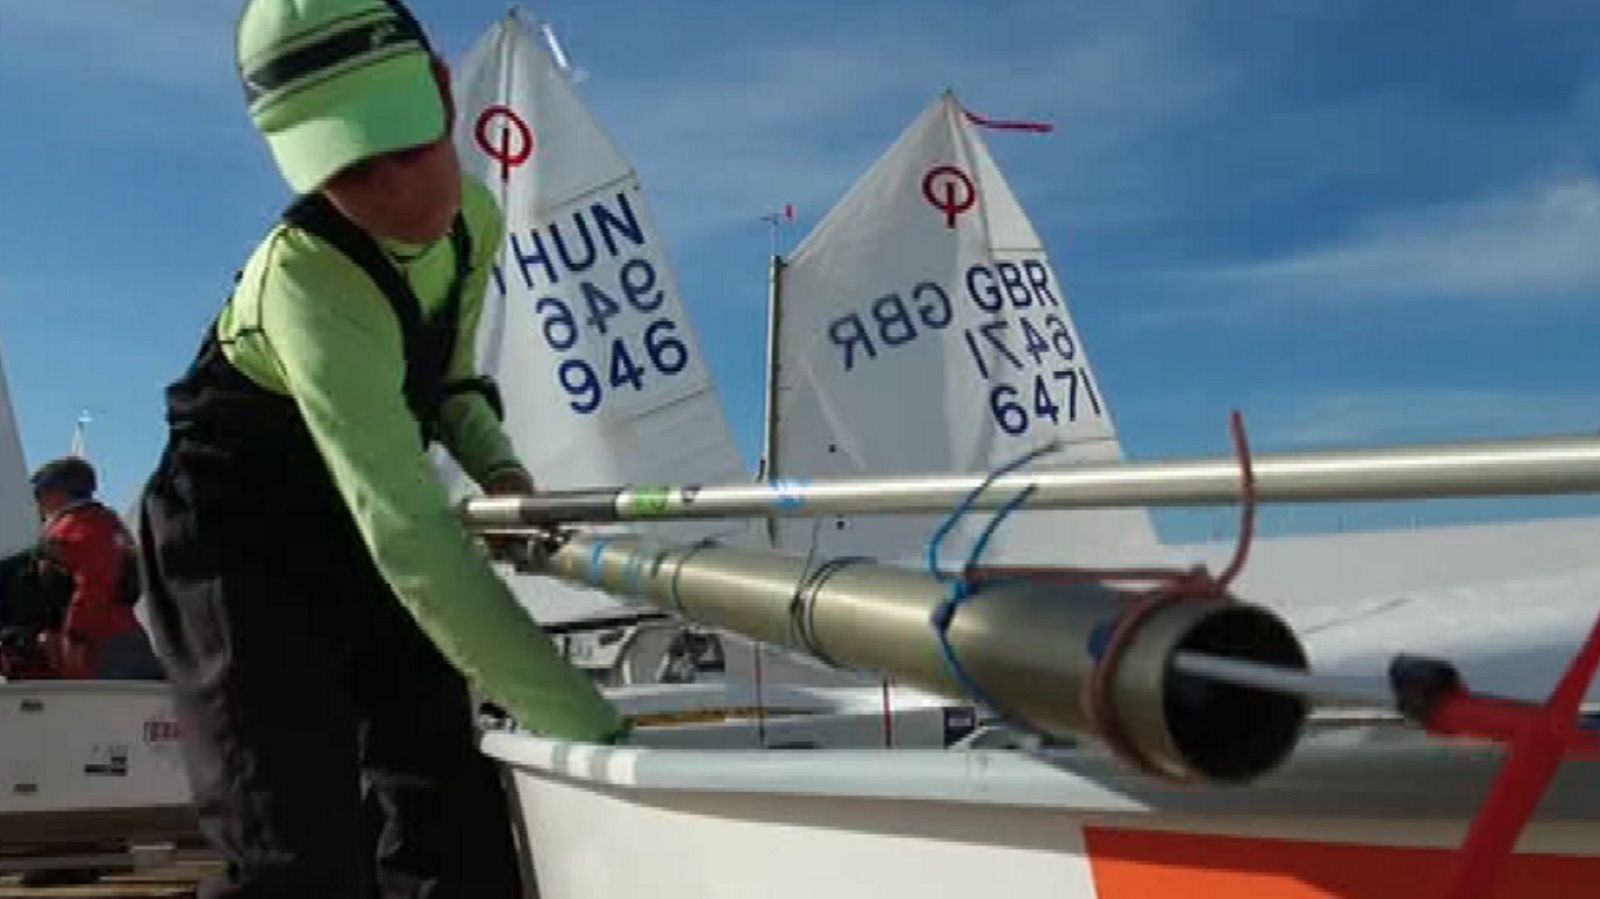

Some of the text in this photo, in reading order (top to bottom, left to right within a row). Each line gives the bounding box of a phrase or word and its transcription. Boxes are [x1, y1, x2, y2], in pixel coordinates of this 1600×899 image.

[510, 193, 645, 288] HUN
[965, 260, 1058, 313] GBR
[558, 318, 688, 414] 946
[990, 368, 1101, 434] 6471
